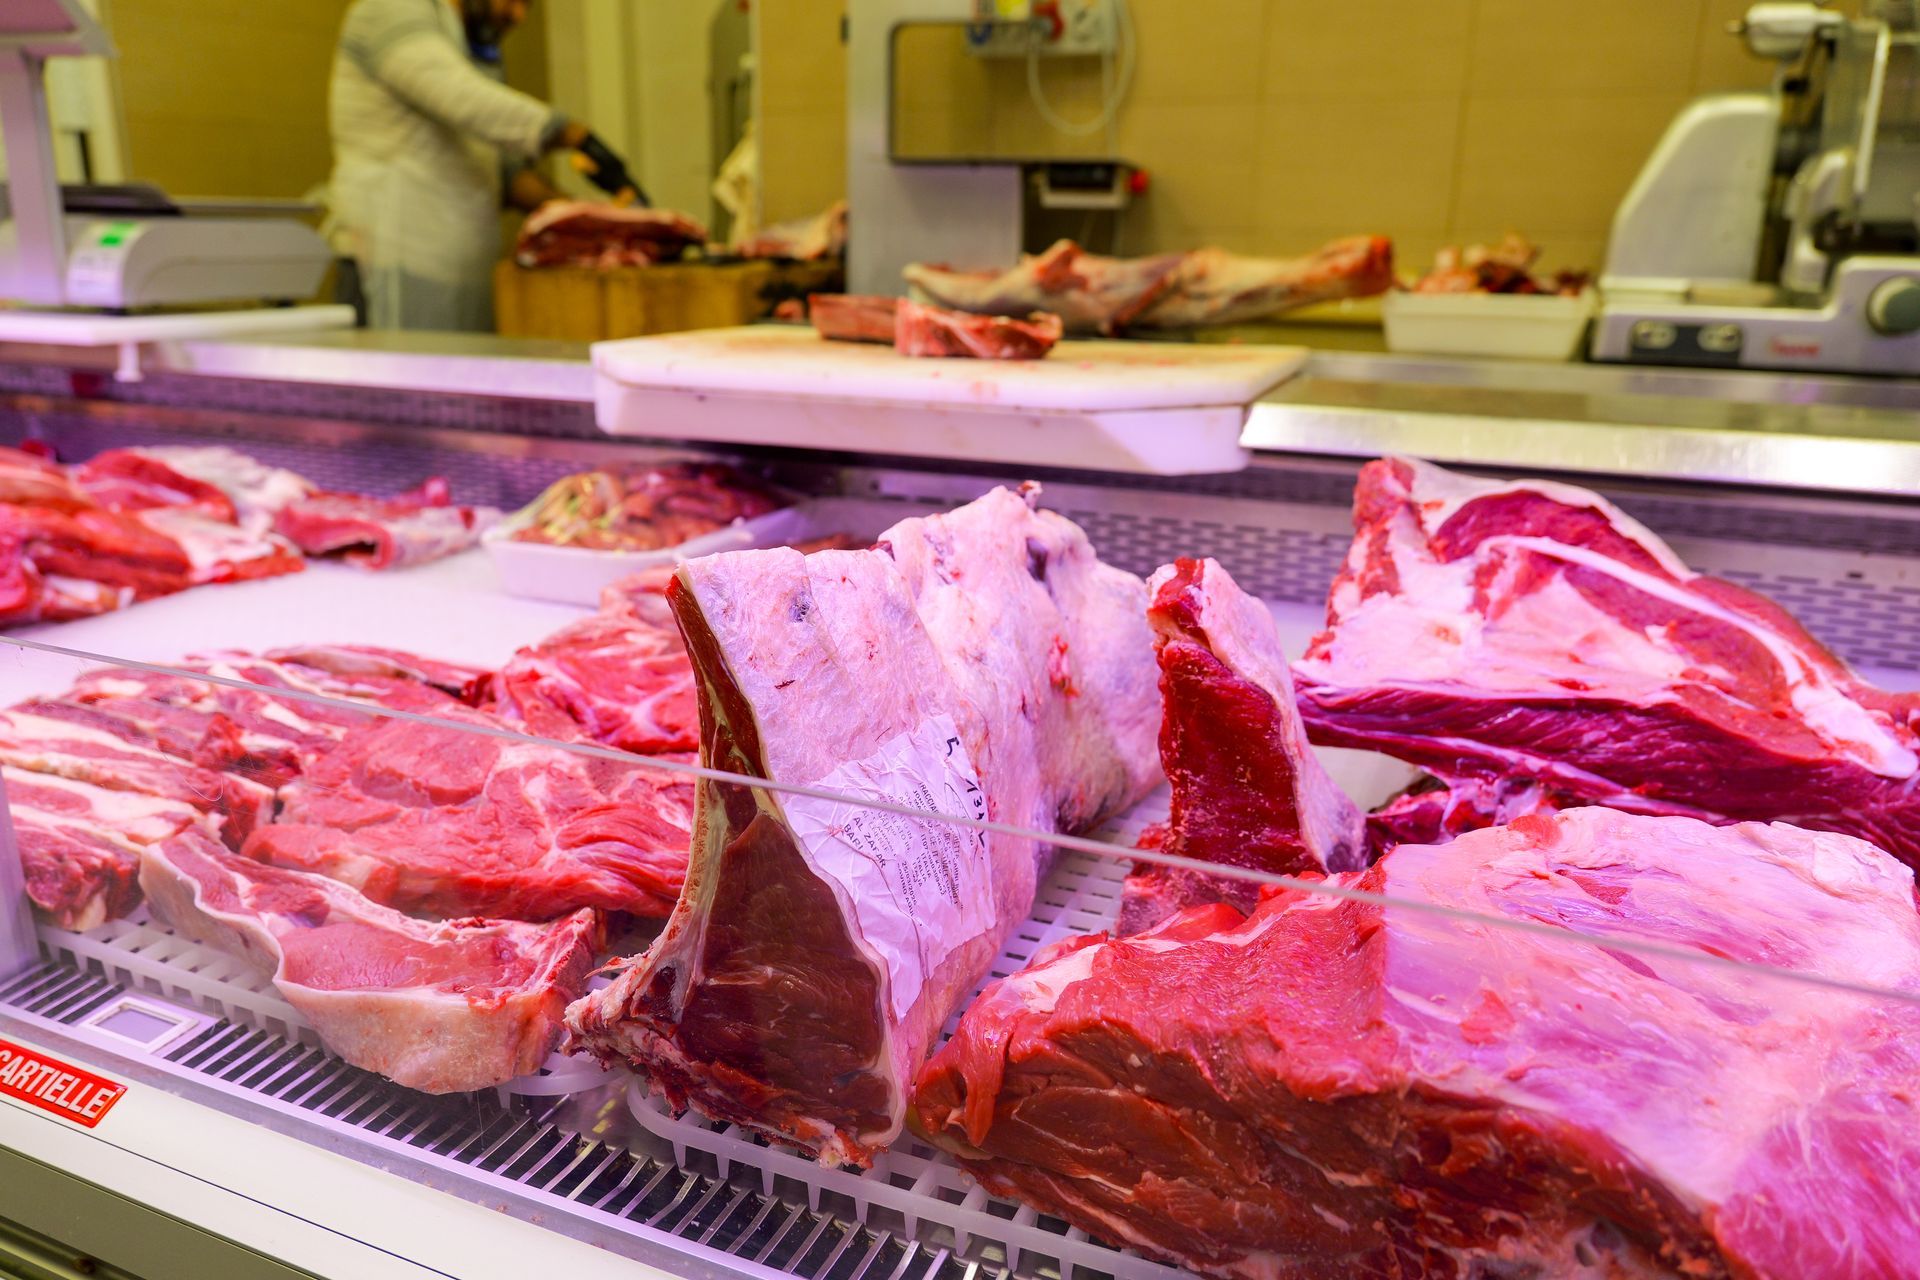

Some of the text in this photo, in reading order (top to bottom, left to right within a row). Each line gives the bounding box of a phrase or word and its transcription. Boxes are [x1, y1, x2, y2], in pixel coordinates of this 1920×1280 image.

[946, 736, 960, 757] 5
[853, 816, 863, 831] AL
[843, 823, 863, 850] BARI
